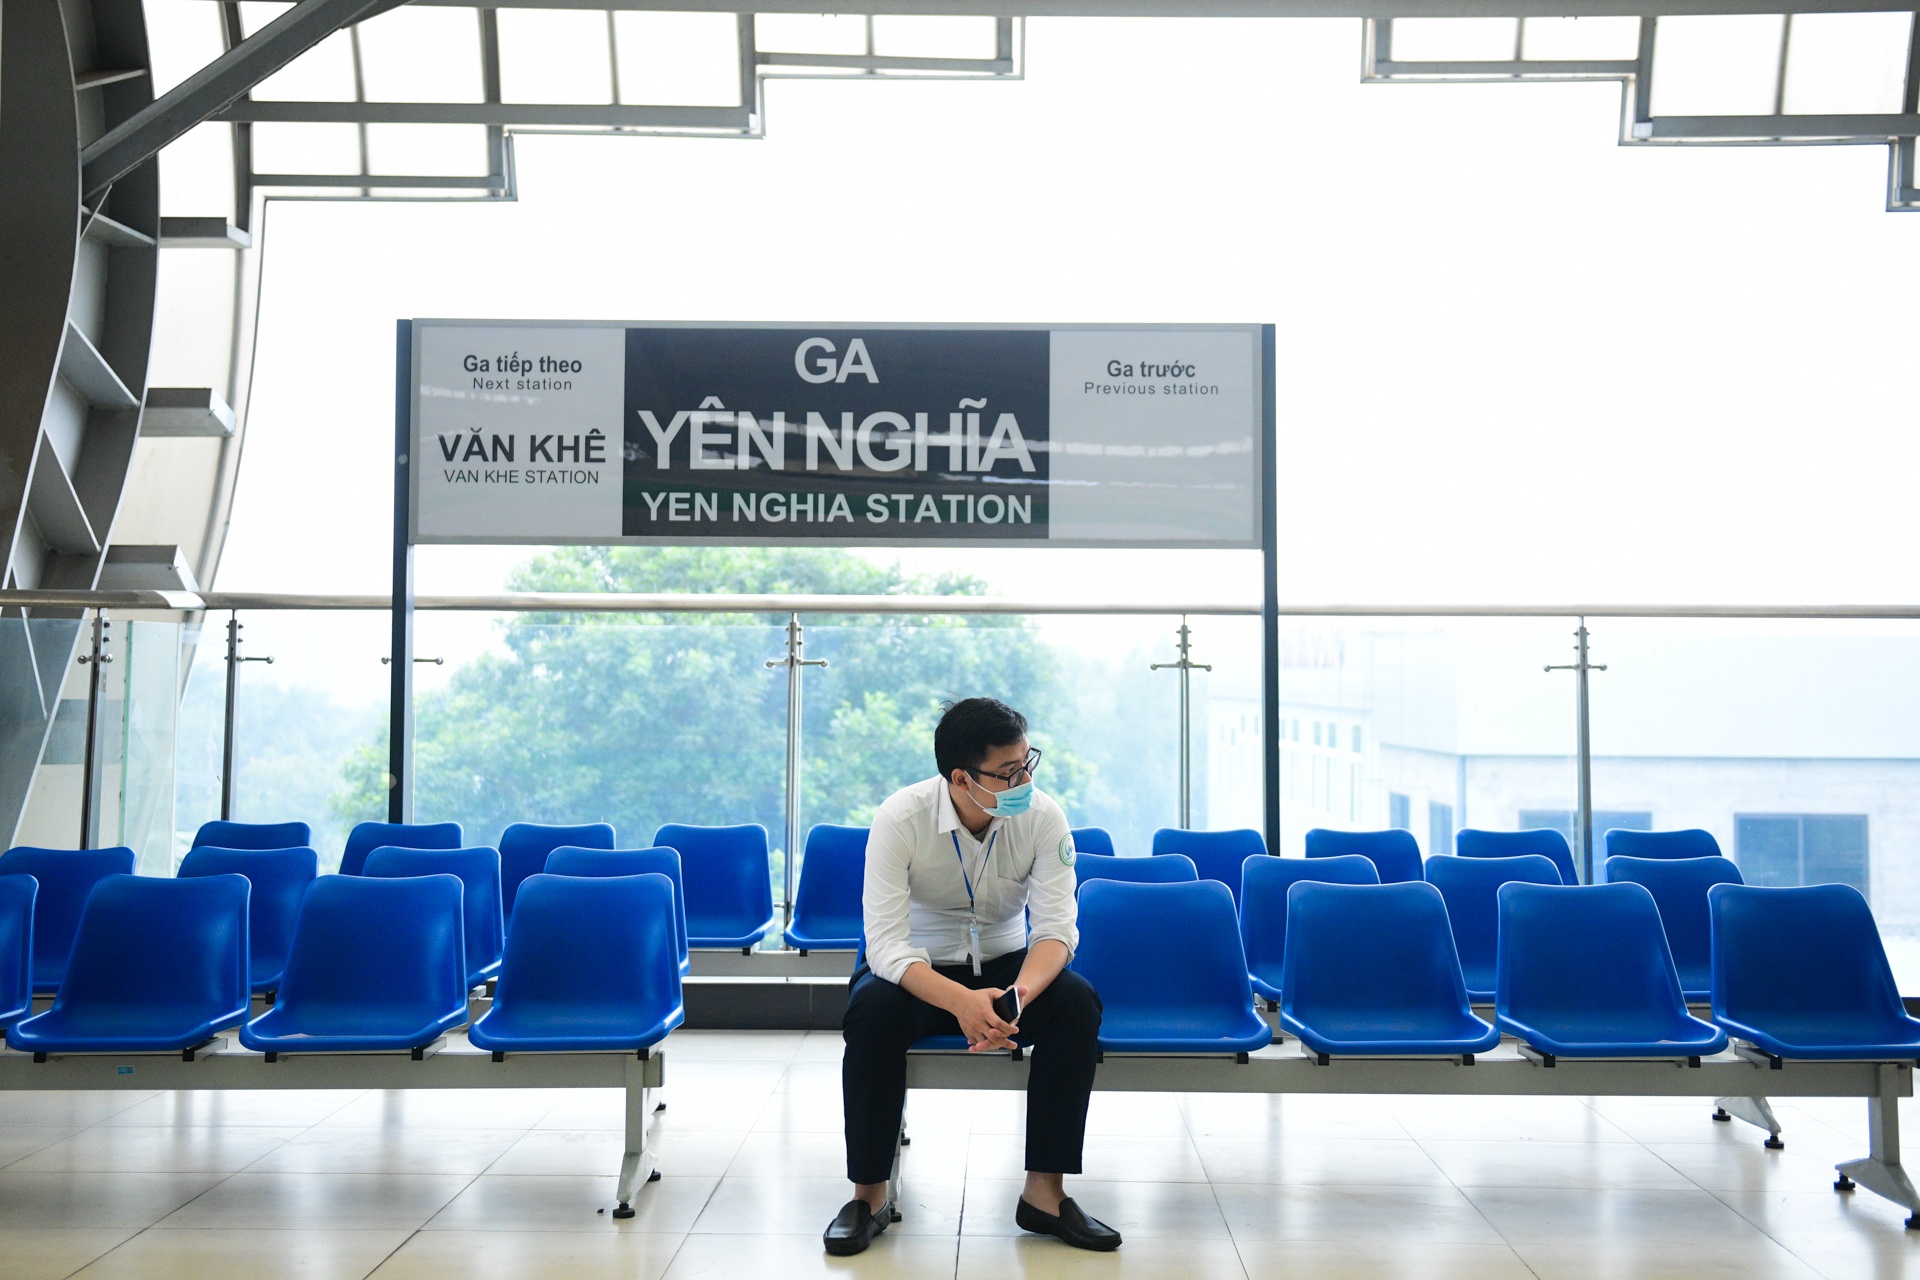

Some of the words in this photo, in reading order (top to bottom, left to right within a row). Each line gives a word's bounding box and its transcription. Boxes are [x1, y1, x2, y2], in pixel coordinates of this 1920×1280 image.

[463, 354, 490, 372] Ga
[496, 351, 533, 377] tiếp
[539, 356, 583, 373] theo
[794, 337, 880, 384] GA
[1107, 359, 1133, 377] Ga
[1140, 360, 1196, 378] trước
[473, 377, 510, 390] Next
[517, 378, 572, 390] station
[1084, 381, 1156, 395] Previous
[1163, 383, 1219, 395] station
[437, 427, 515, 462] VĂN
[529, 428, 606, 463] KHÊ
[637, 395, 785, 471] YÊN
[805, 397, 1037, 472] NGHĨA
[444, 469, 479, 483] VAN
[484, 470, 520, 484] KHE
[525, 470, 599, 484] STATION
[641, 491, 718, 522] YEN
[732, 492, 855, 523] NGHIA
[865, 493, 1032, 524] STATION
